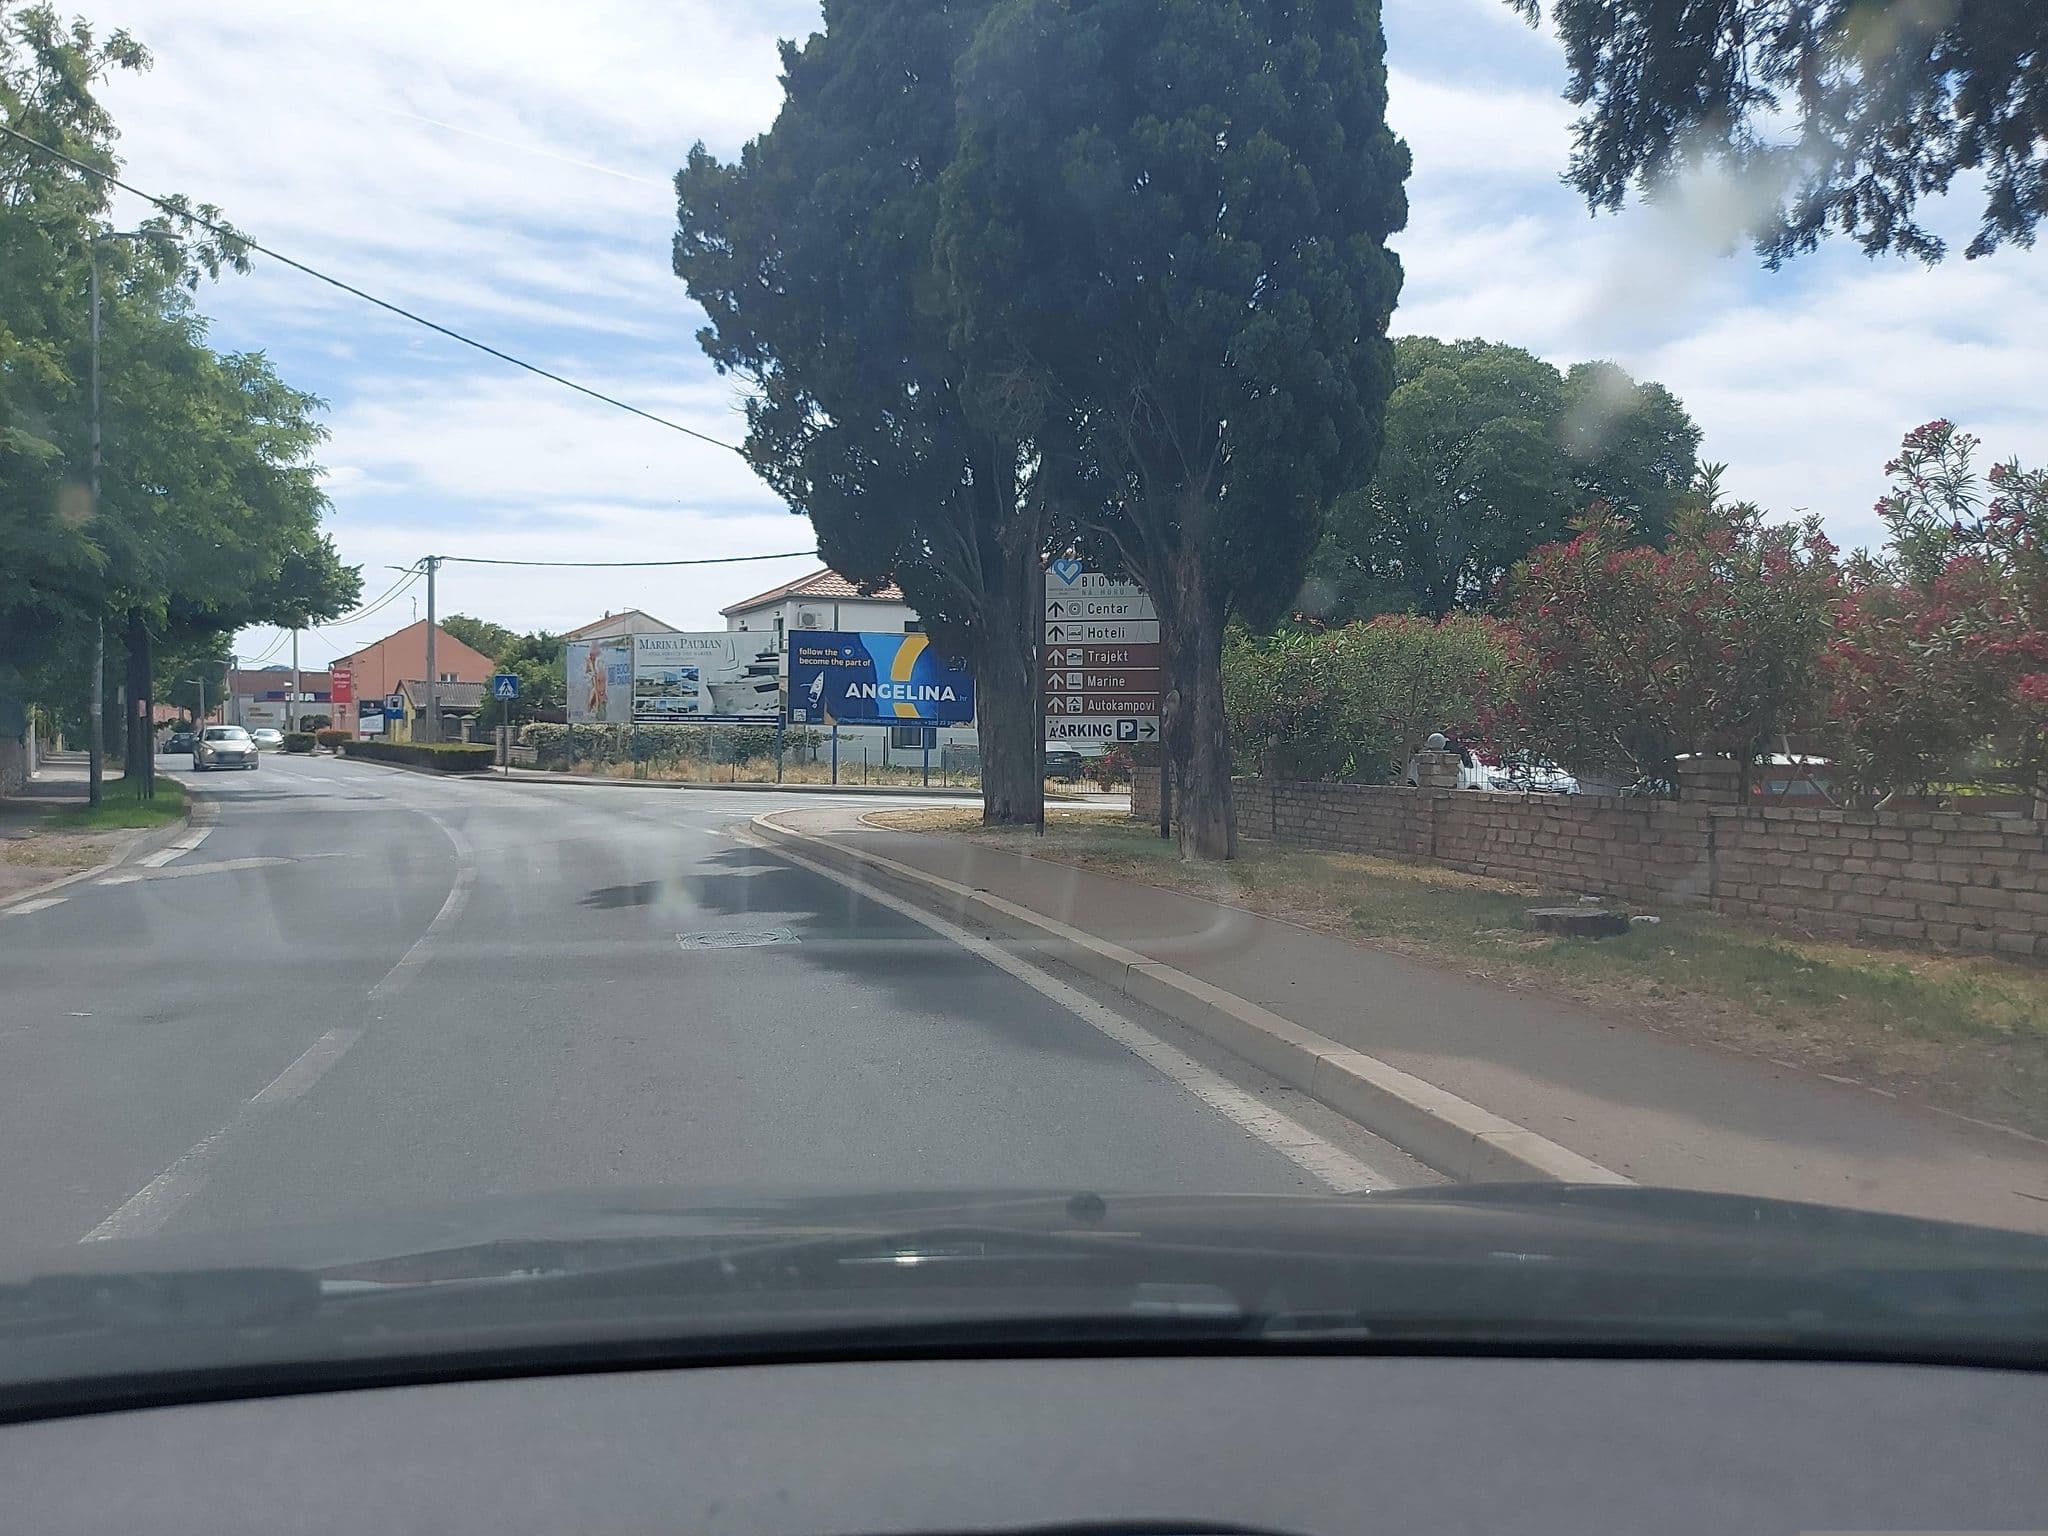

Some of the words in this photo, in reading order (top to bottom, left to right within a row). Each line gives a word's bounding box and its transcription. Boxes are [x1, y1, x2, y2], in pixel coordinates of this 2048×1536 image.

[1087, 602, 1128, 615] Centar
[1087, 627, 1125, 639] Hoteli
[639, 639, 678, 650] MARINA
[799, 648, 823, 656] follow
[825, 648, 838, 656] the
[1087, 650, 1129, 665] Trajekt
[799, 657, 829, 665] become
[831, 658, 844, 666] the
[845, 659, 861, 668] part
[1087, 675, 1126, 687] Marine
[845, 683, 956, 702] ANGELINA
[1087, 700, 1155, 713] Autokampovi
